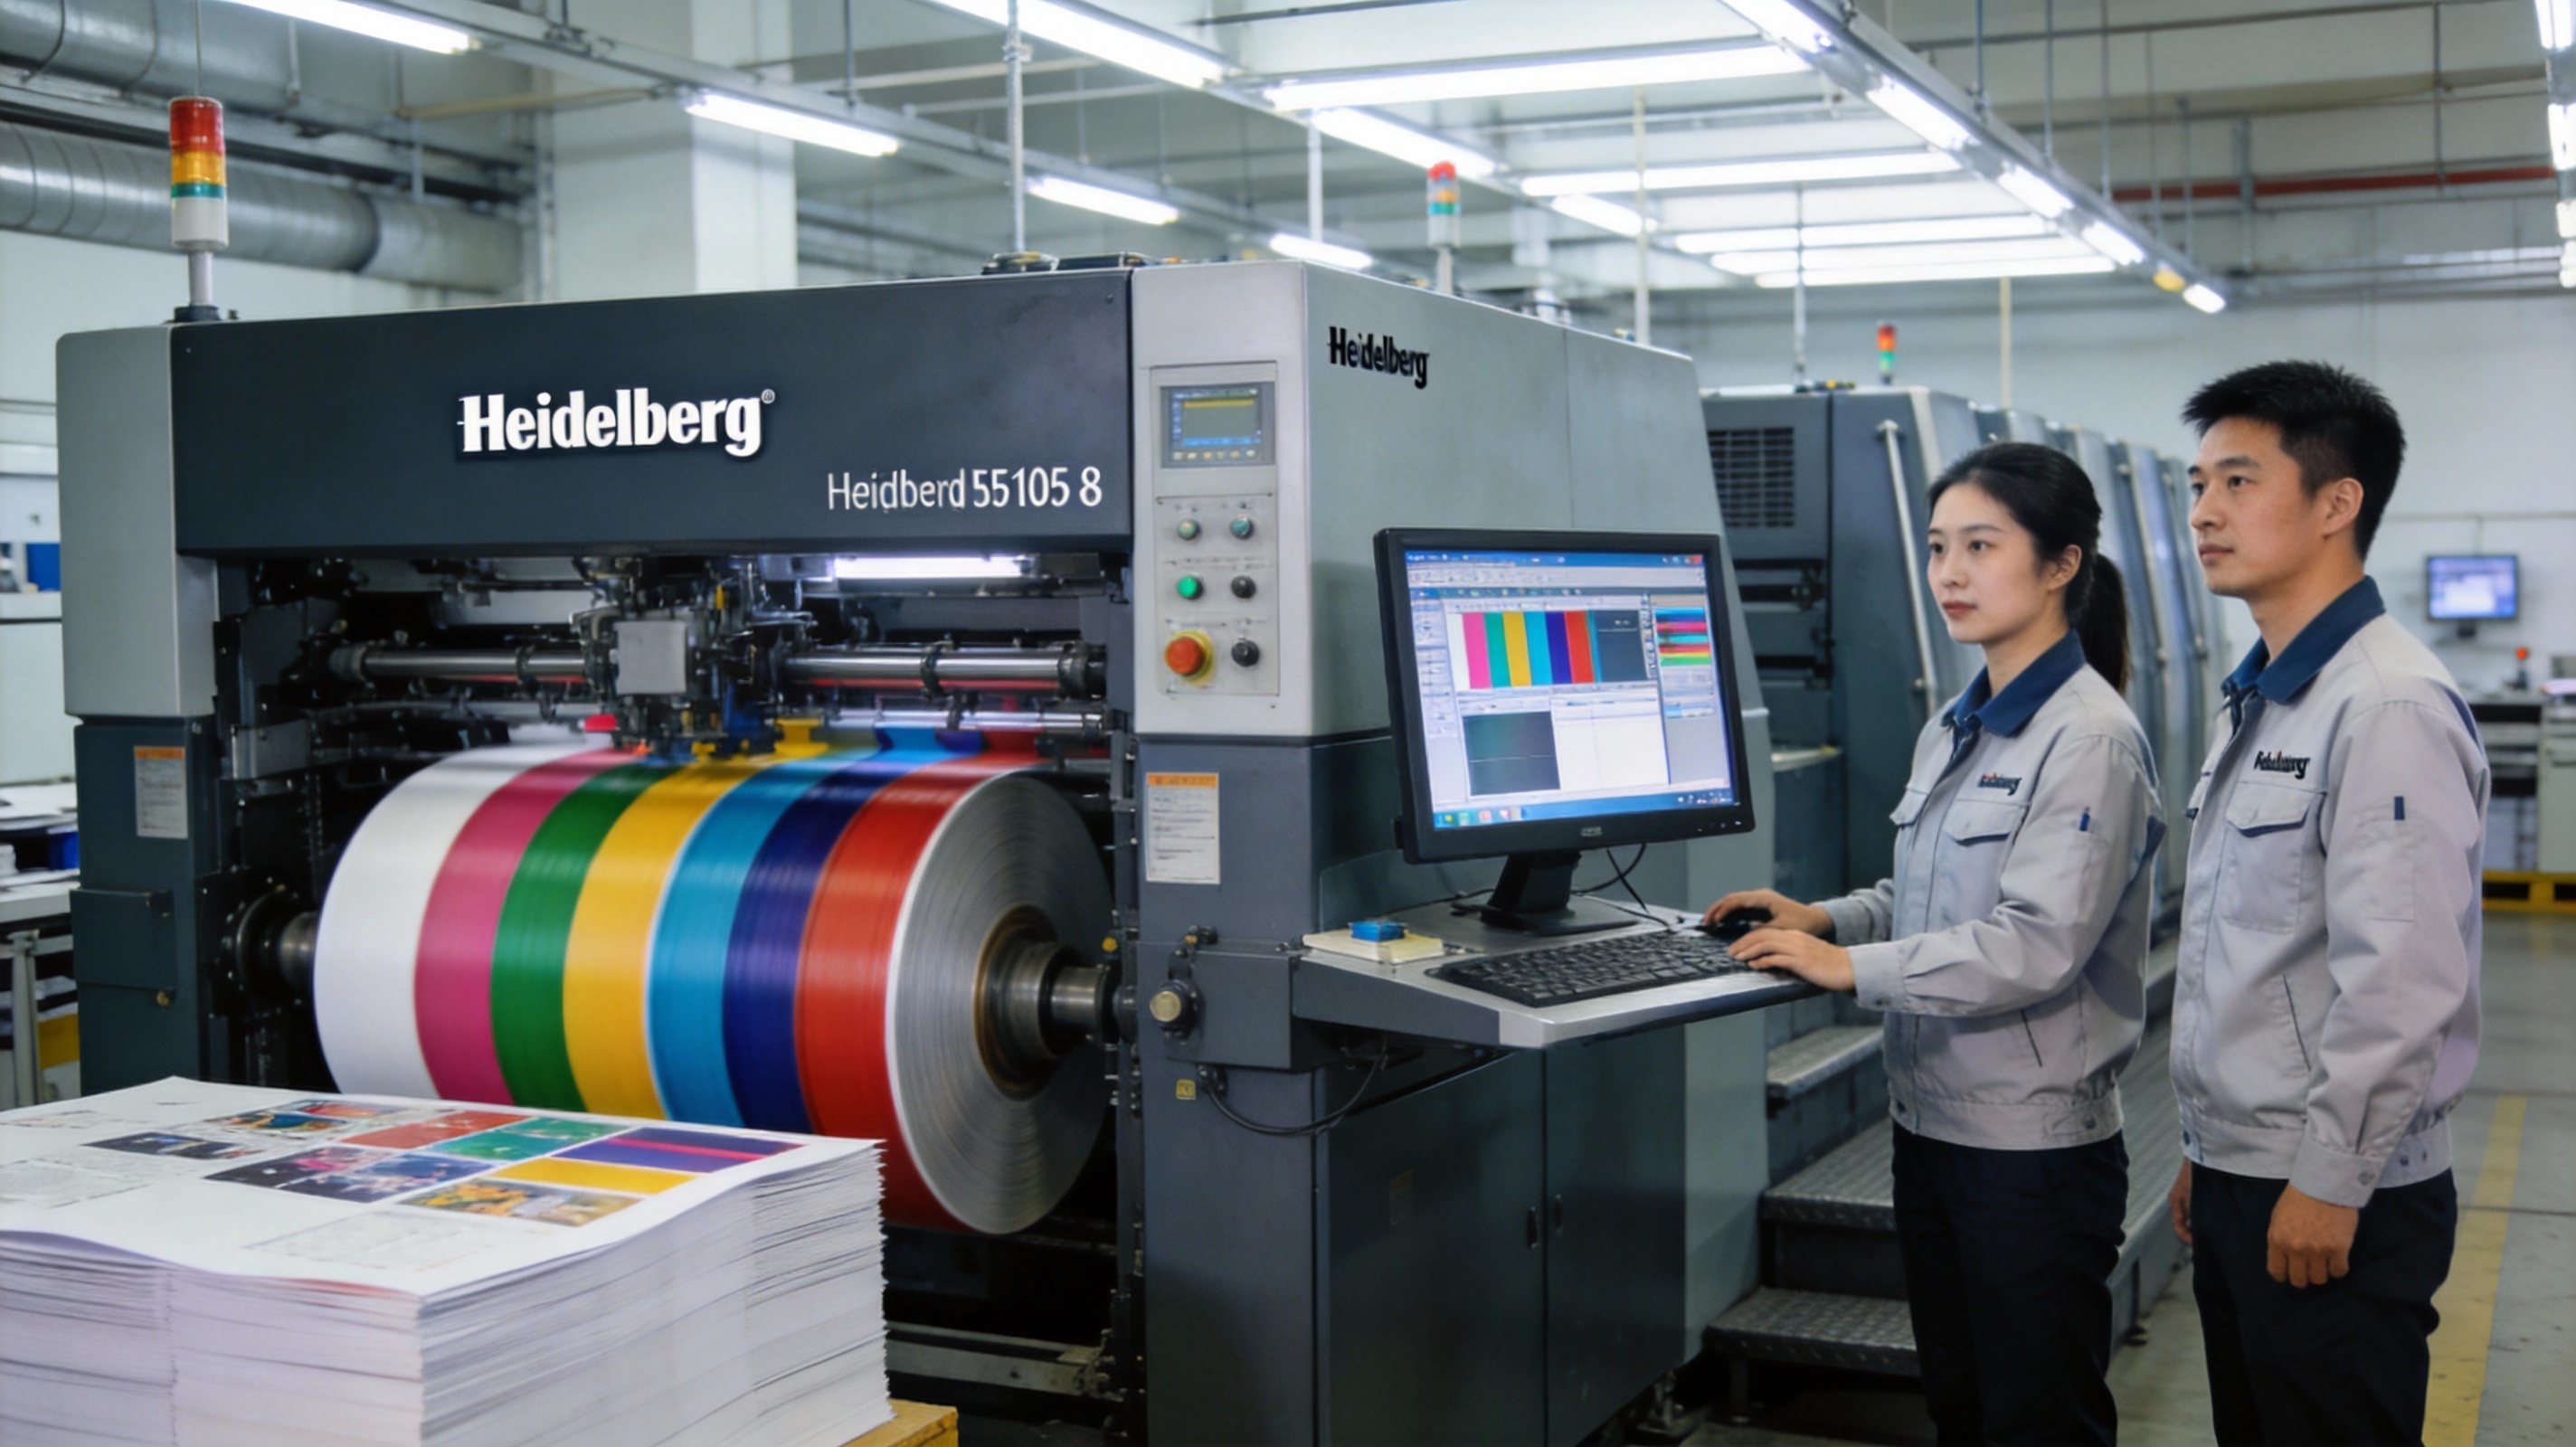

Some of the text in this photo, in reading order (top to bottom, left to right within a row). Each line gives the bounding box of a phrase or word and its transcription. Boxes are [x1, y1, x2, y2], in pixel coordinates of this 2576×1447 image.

[828, 466, 1103, 511] Heidberd 55105 8
